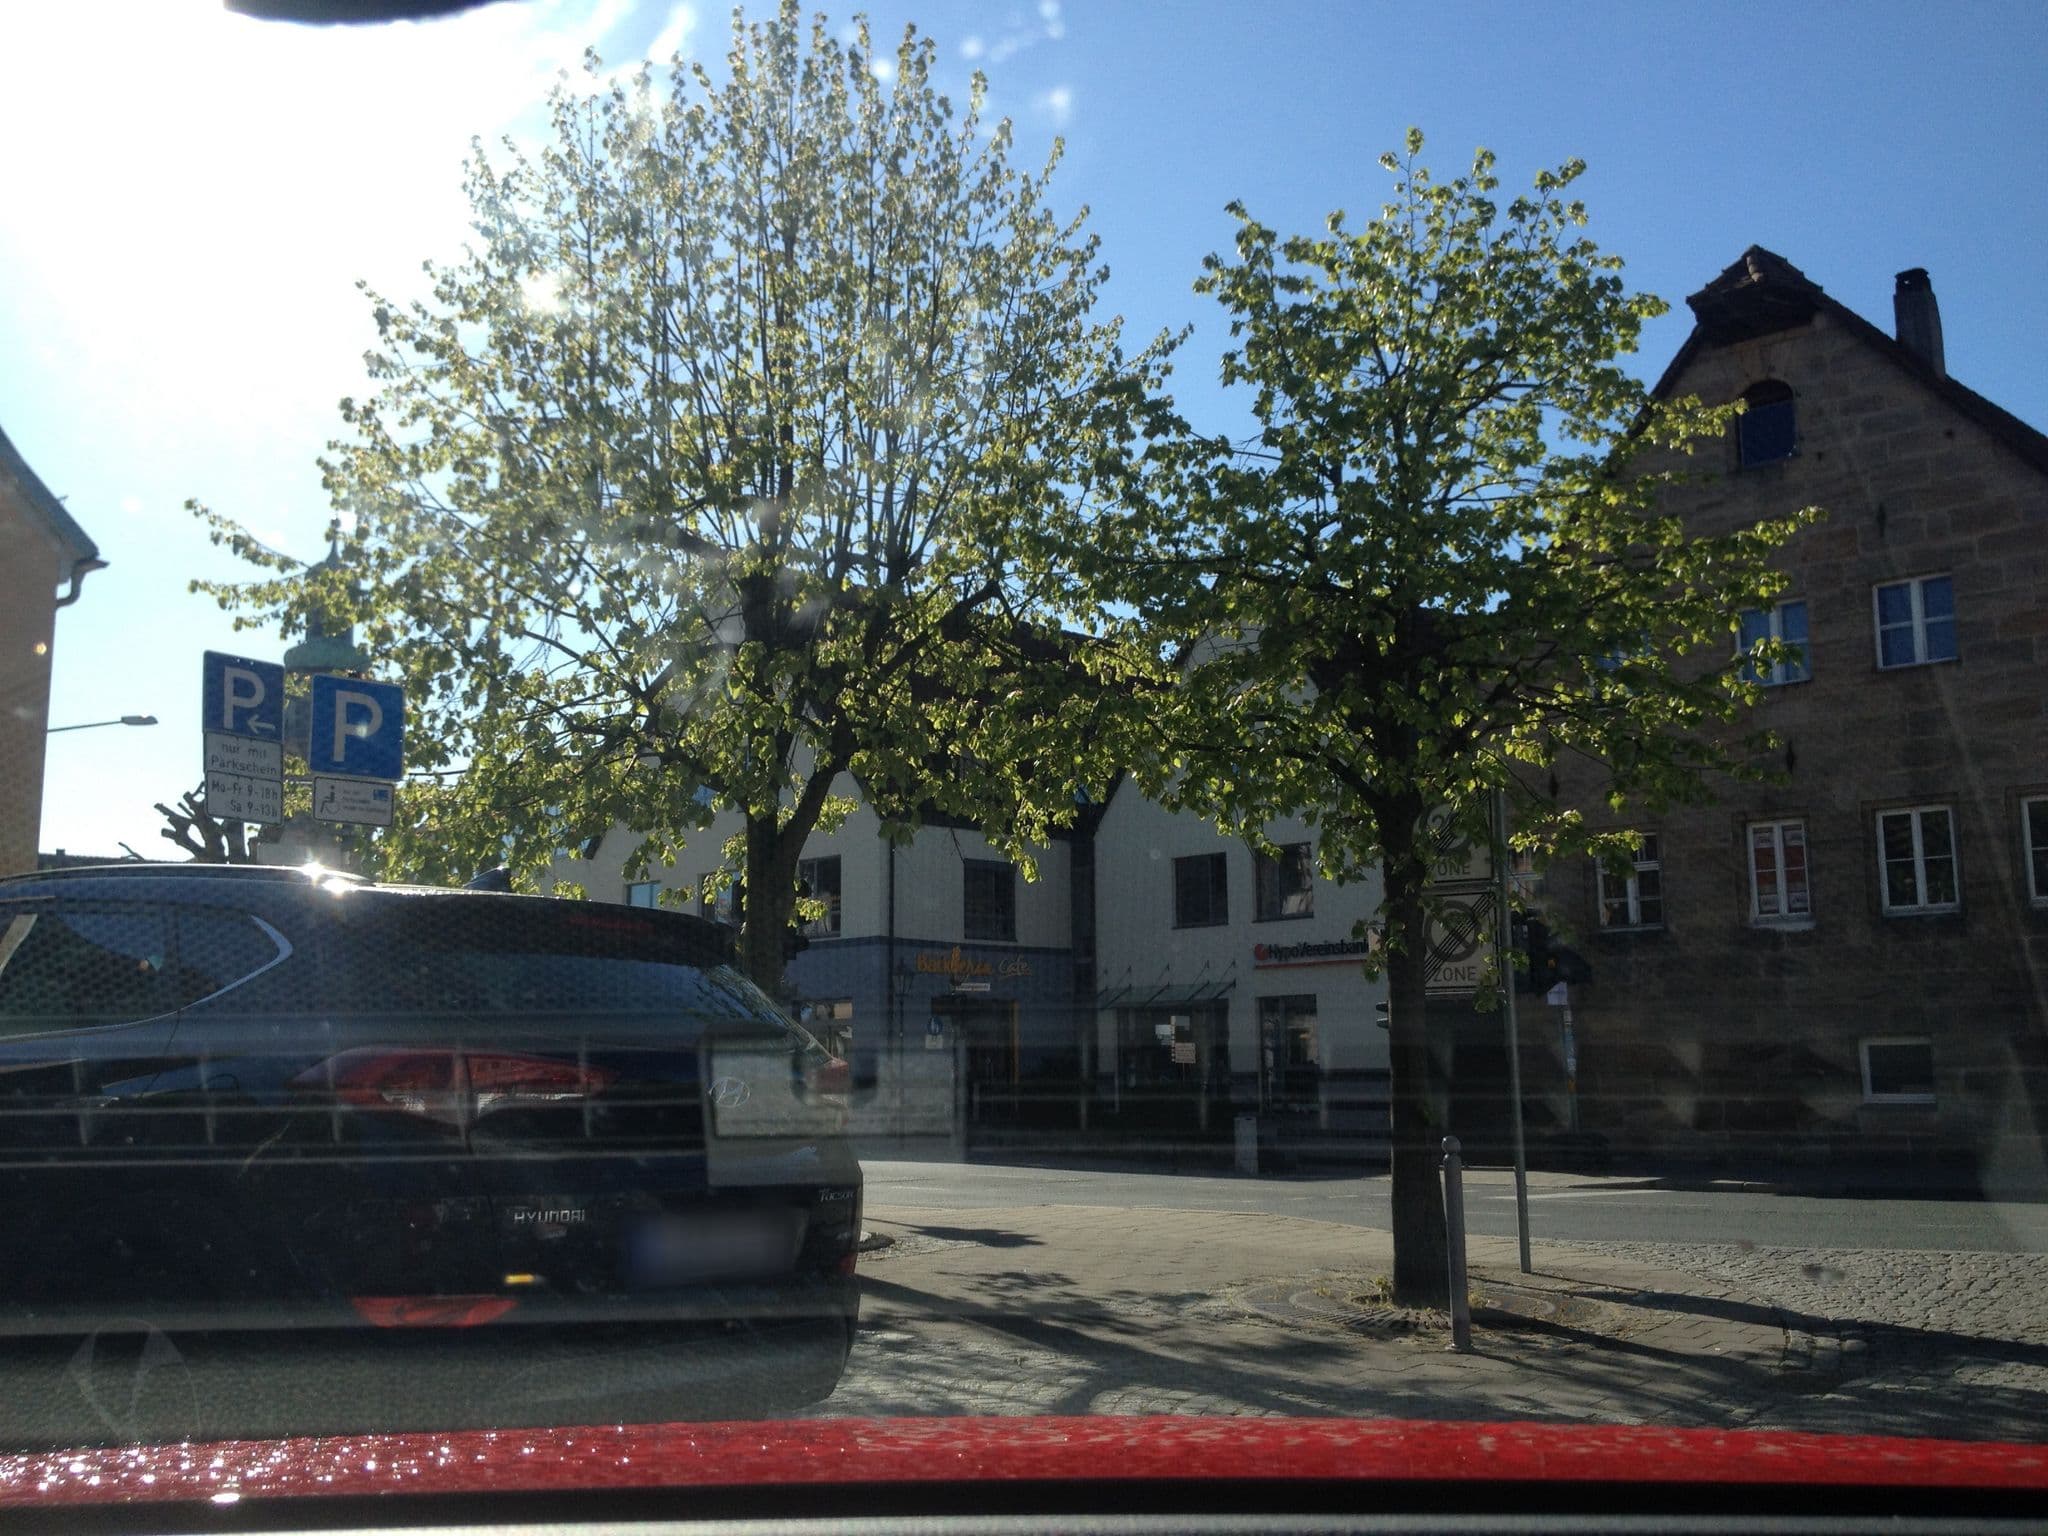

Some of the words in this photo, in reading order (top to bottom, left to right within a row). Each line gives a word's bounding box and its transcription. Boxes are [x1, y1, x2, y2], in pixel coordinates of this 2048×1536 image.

[224, 667, 265, 729] P
[334, 690, 383, 762] P
[222, 743, 240, 754] nur
[247, 746, 266, 758] mit
[211, 755, 278, 776] Parkschein
[230, 800, 242, 812] Sa
[514, 1209, 585, 1223] HYUNDAI
